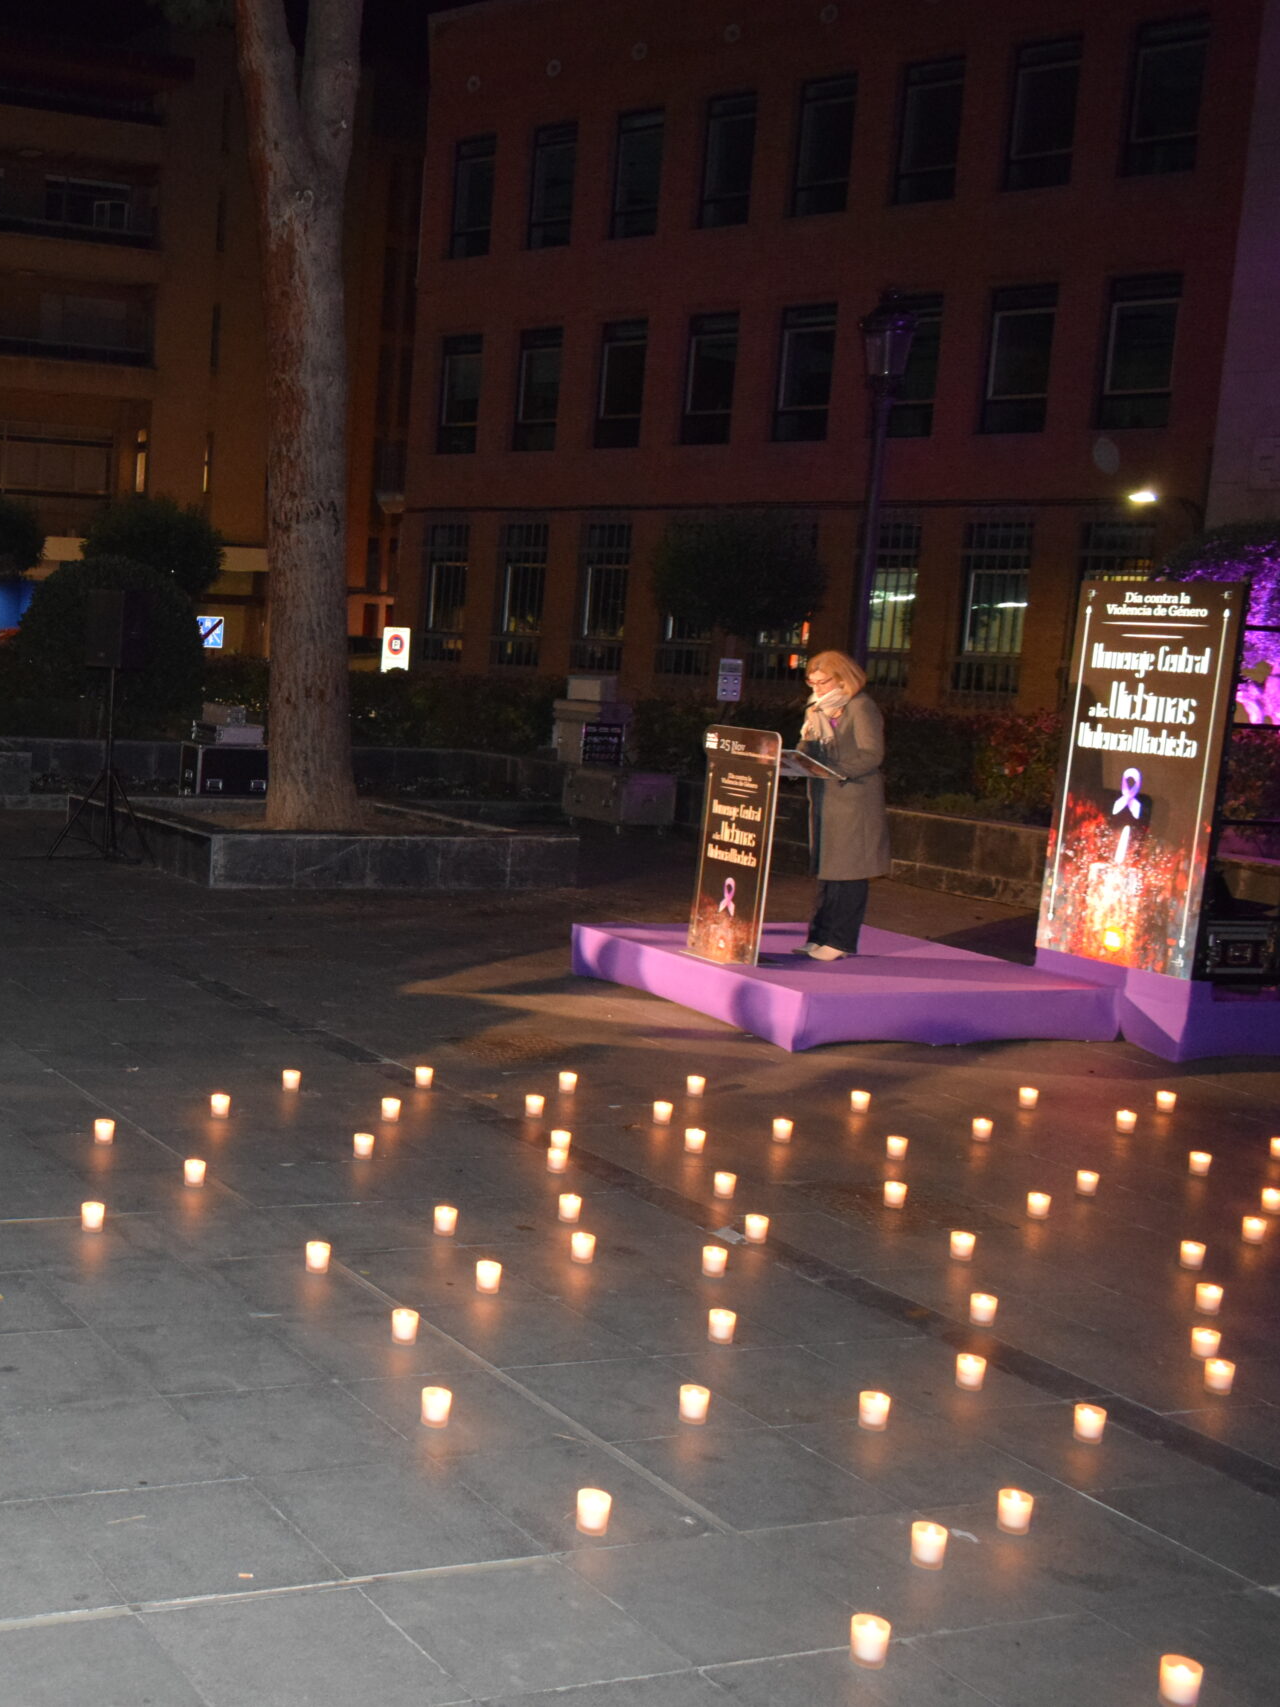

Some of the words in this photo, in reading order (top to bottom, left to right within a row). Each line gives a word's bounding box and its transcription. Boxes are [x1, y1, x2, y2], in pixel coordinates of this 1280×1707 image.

[1124, 591, 1143, 604] Día
[1144, 593, 1179, 604] contra
[1180, 592, 1191, 604] la
[1106, 603, 1152, 616] Violencia
[1153, 605, 1168, 616] de
[1168, 604, 1208, 617] Género
[1091, 643, 1156, 678] Homenaje
[1157, 645, 1211, 674] Central
[720, 739, 731, 751] 25
[732, 740, 746, 751] Nov
